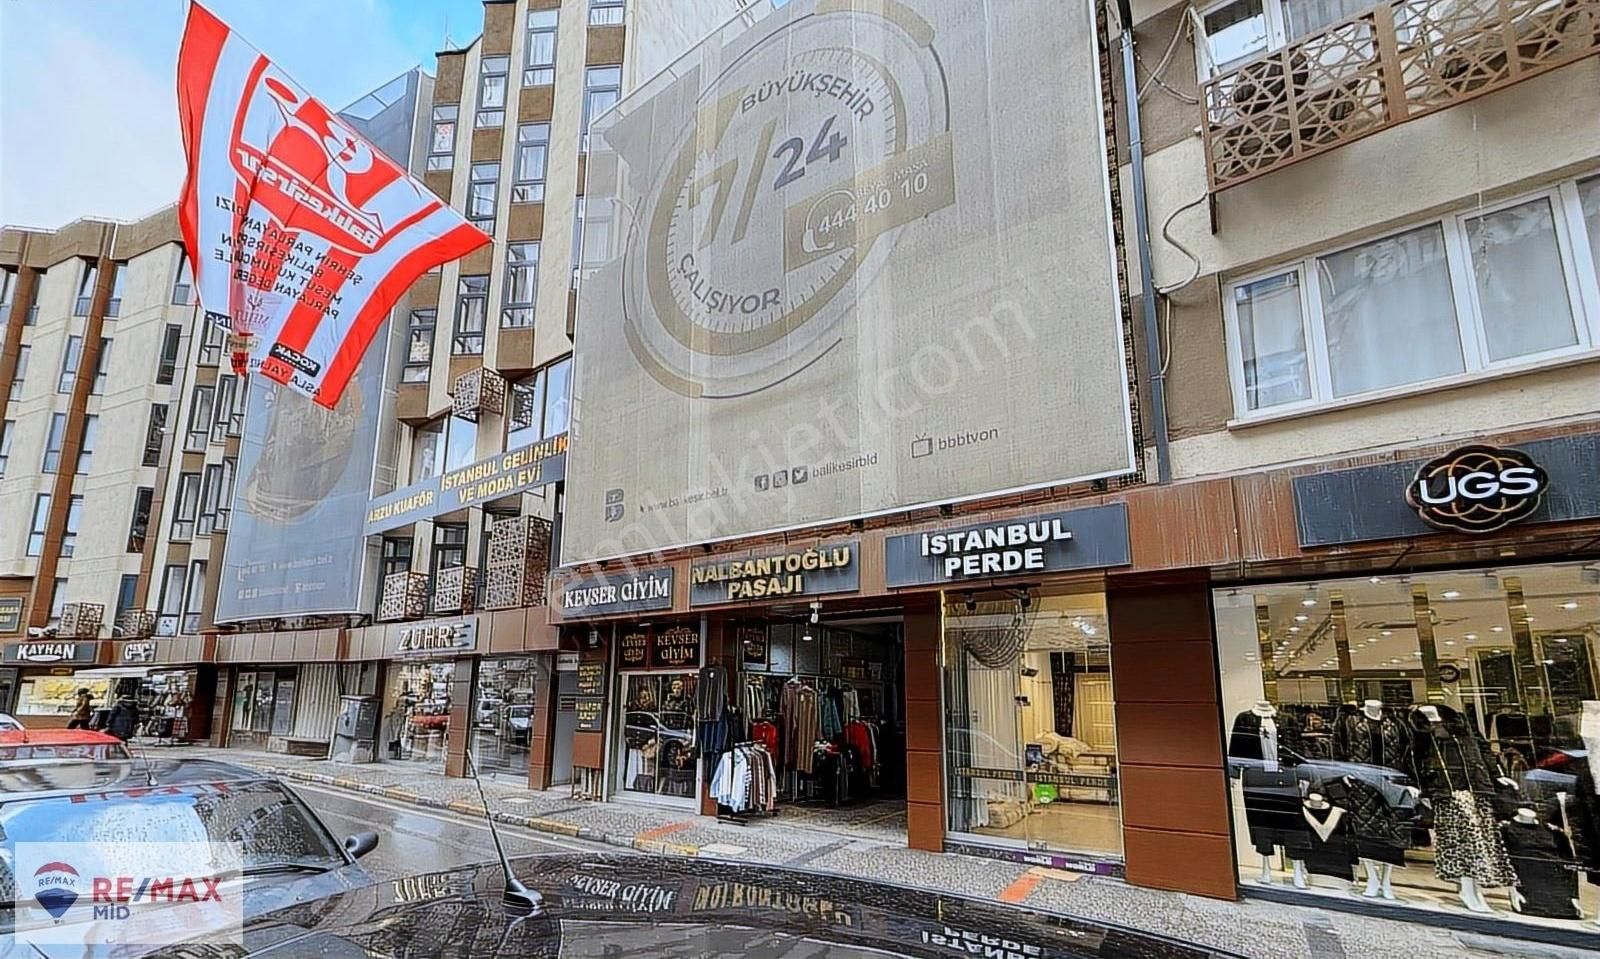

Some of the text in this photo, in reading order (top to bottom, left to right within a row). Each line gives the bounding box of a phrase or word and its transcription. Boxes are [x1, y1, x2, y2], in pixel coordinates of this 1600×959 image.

[741, 70, 874, 121] BÜYÜKŞEHİR
[819, 172, 929, 234] 444 40 10
[677, 253, 781, 314] ÇALIŞIYOR
[938, 427, 999, 451] bbbtvon
[441, 434, 568, 492] İSTANBUL GELİNLİK
[459, 462, 542, 504] VE MODA EVİ
[1419, 467, 1539, 504] UGS
[393, 489, 434, 517] KUAFÖR
[921, 519, 1072, 556] İSTANBUL
[691, 547, 850, 585] NALBANTOĞLU
[945, 547, 1044, 577] PERDE
[564, 575, 669, 609] KEVSER GİYİM
[727, 575, 803, 600] PASAJI
[17, 643, 76, 660] KAYHAN
[657, 633, 699, 647] KEVSER
[661, 645, 694, 660] GİYİM
